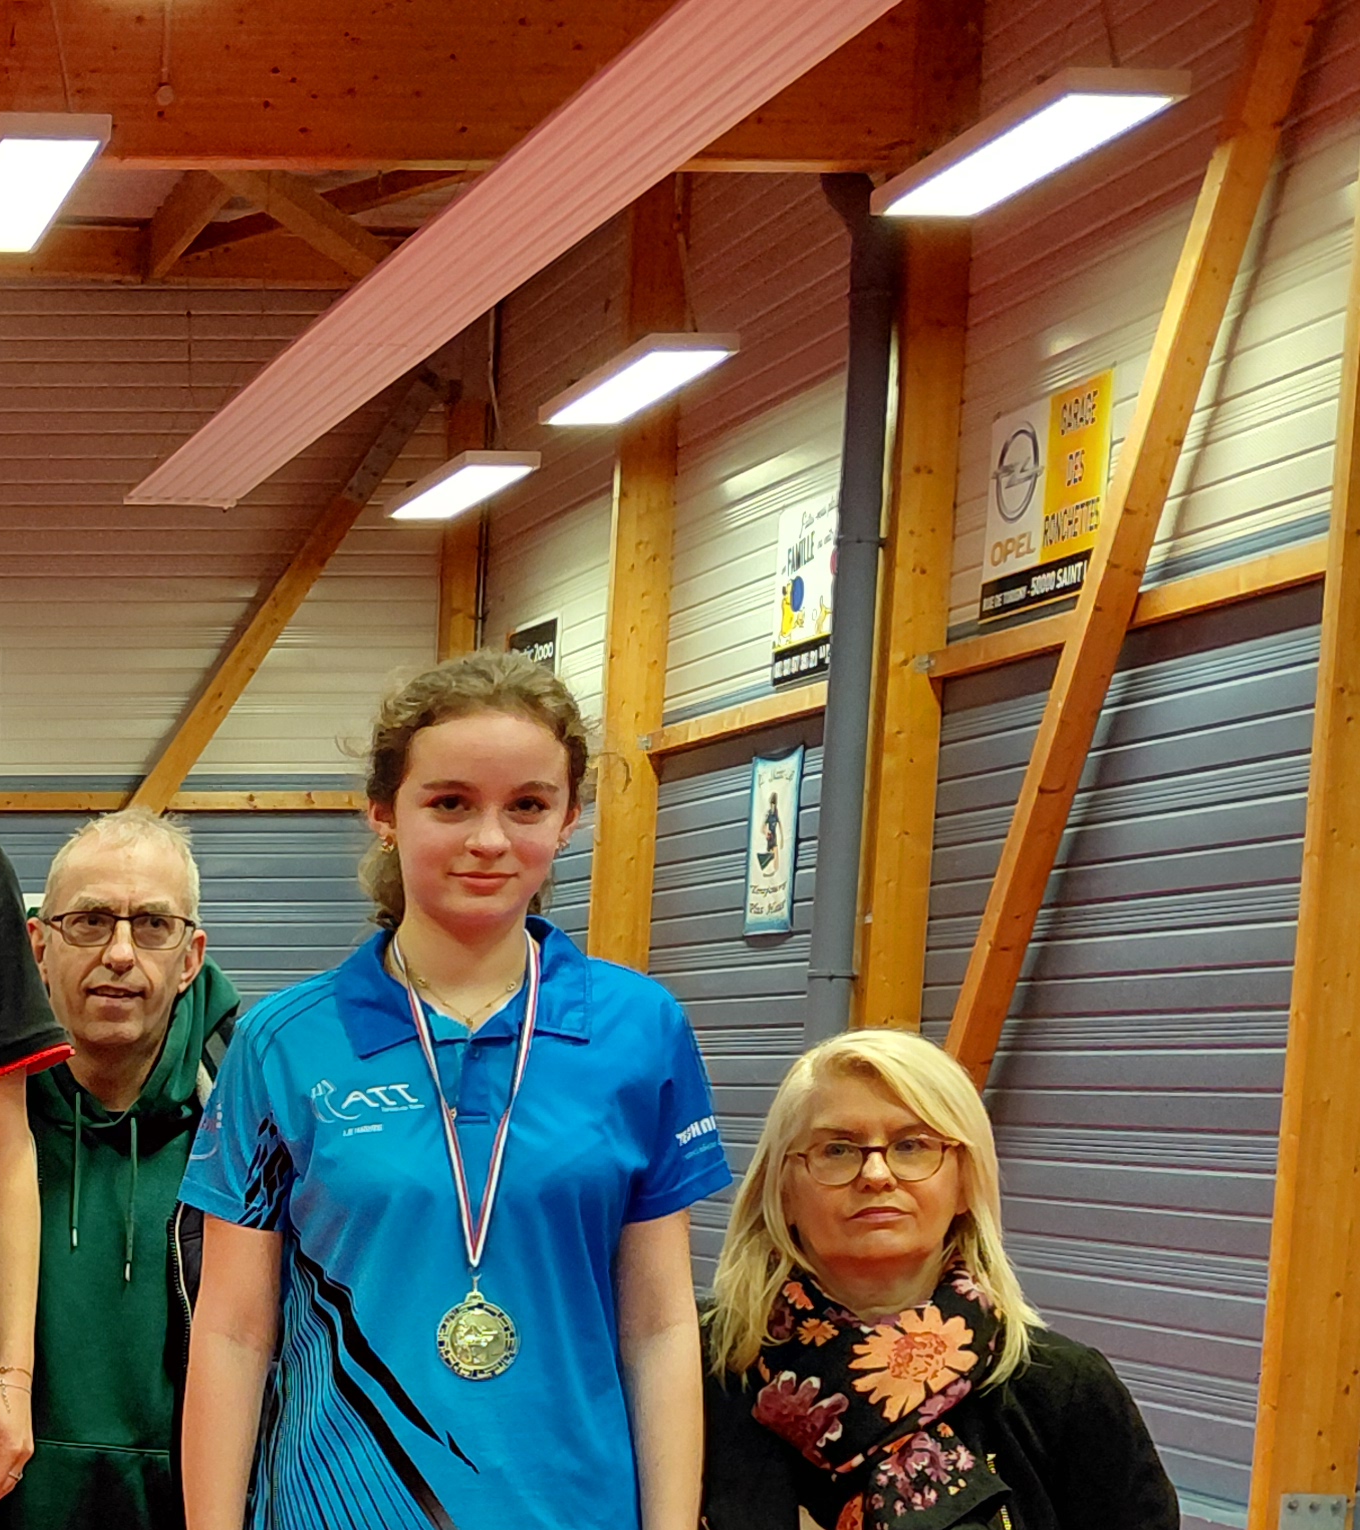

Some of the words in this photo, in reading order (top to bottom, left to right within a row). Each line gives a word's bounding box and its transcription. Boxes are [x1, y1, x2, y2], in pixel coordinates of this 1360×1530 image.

[1061, 390, 1099, 436] GARAGE
[990, 531, 1037, 568] OPEL
[1056, 561, 1084, 589] SAINT
